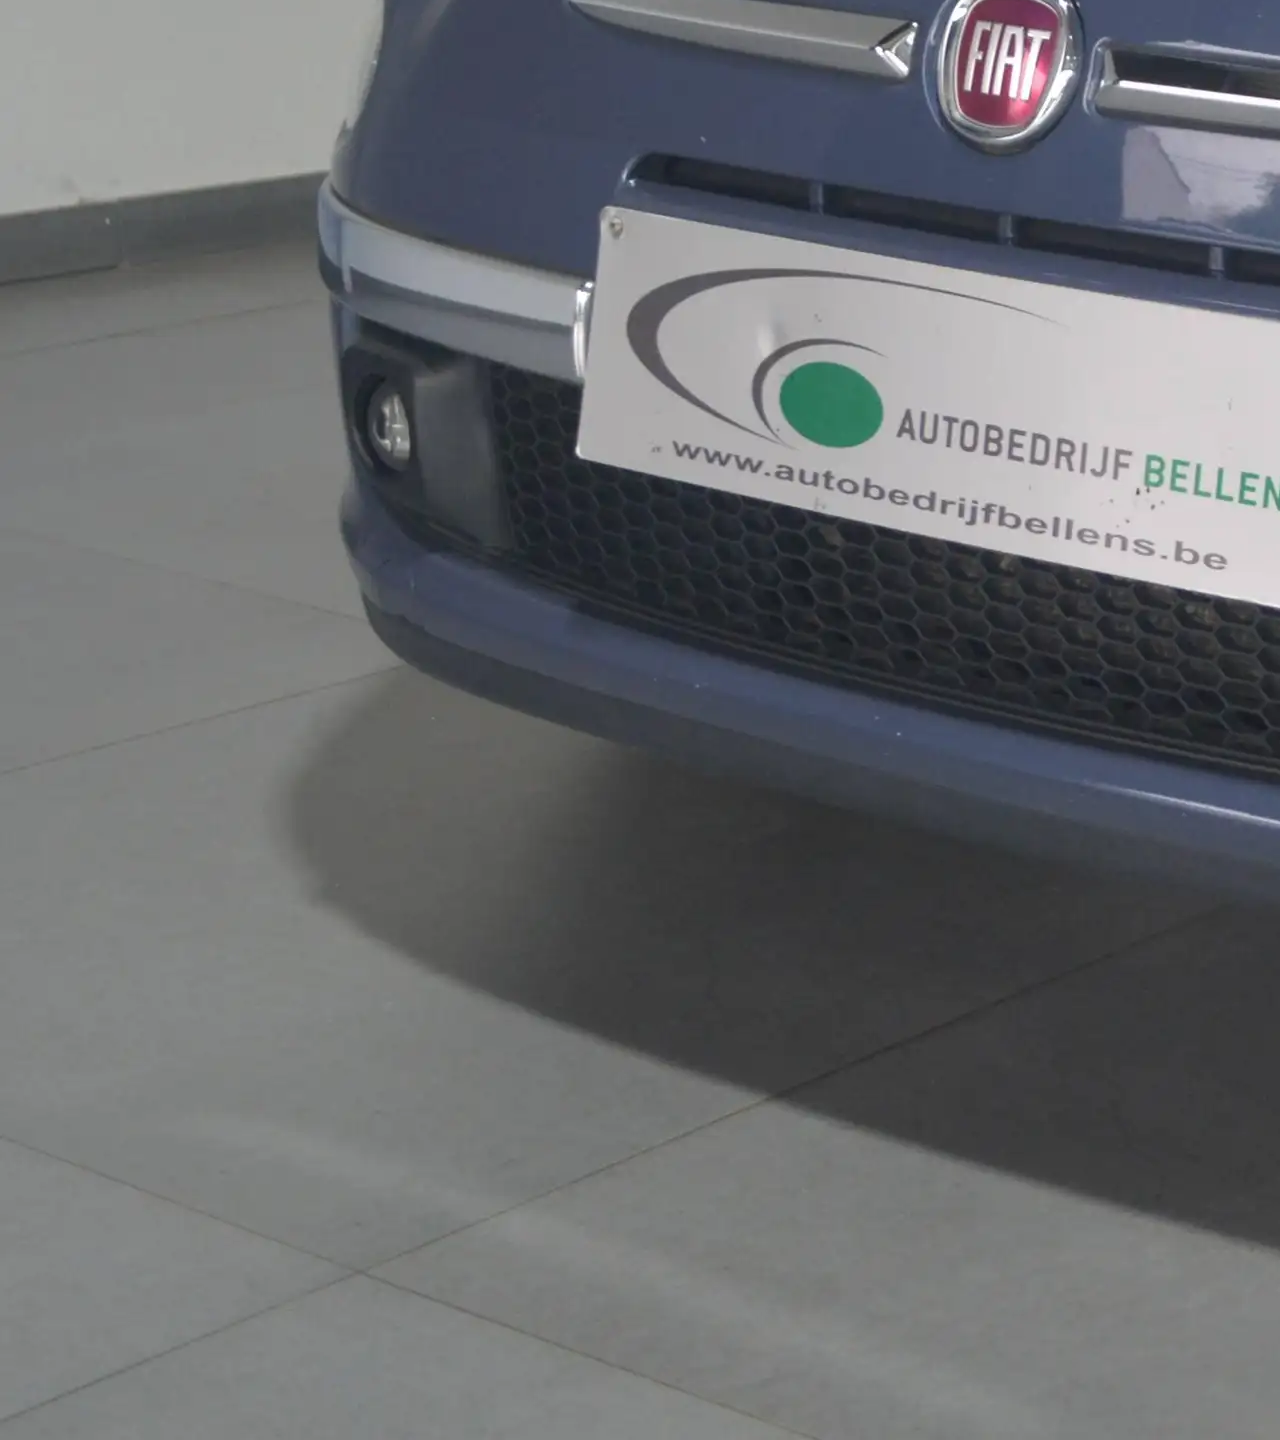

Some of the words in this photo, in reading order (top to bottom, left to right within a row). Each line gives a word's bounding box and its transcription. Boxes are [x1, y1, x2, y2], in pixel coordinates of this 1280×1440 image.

[963, 19, 1052, 101] FIAT
[895, 407, 1133, 481] AUTOBEDRIJF
[672, 439, 1229, 571] www.autobedrijfbellens.be
